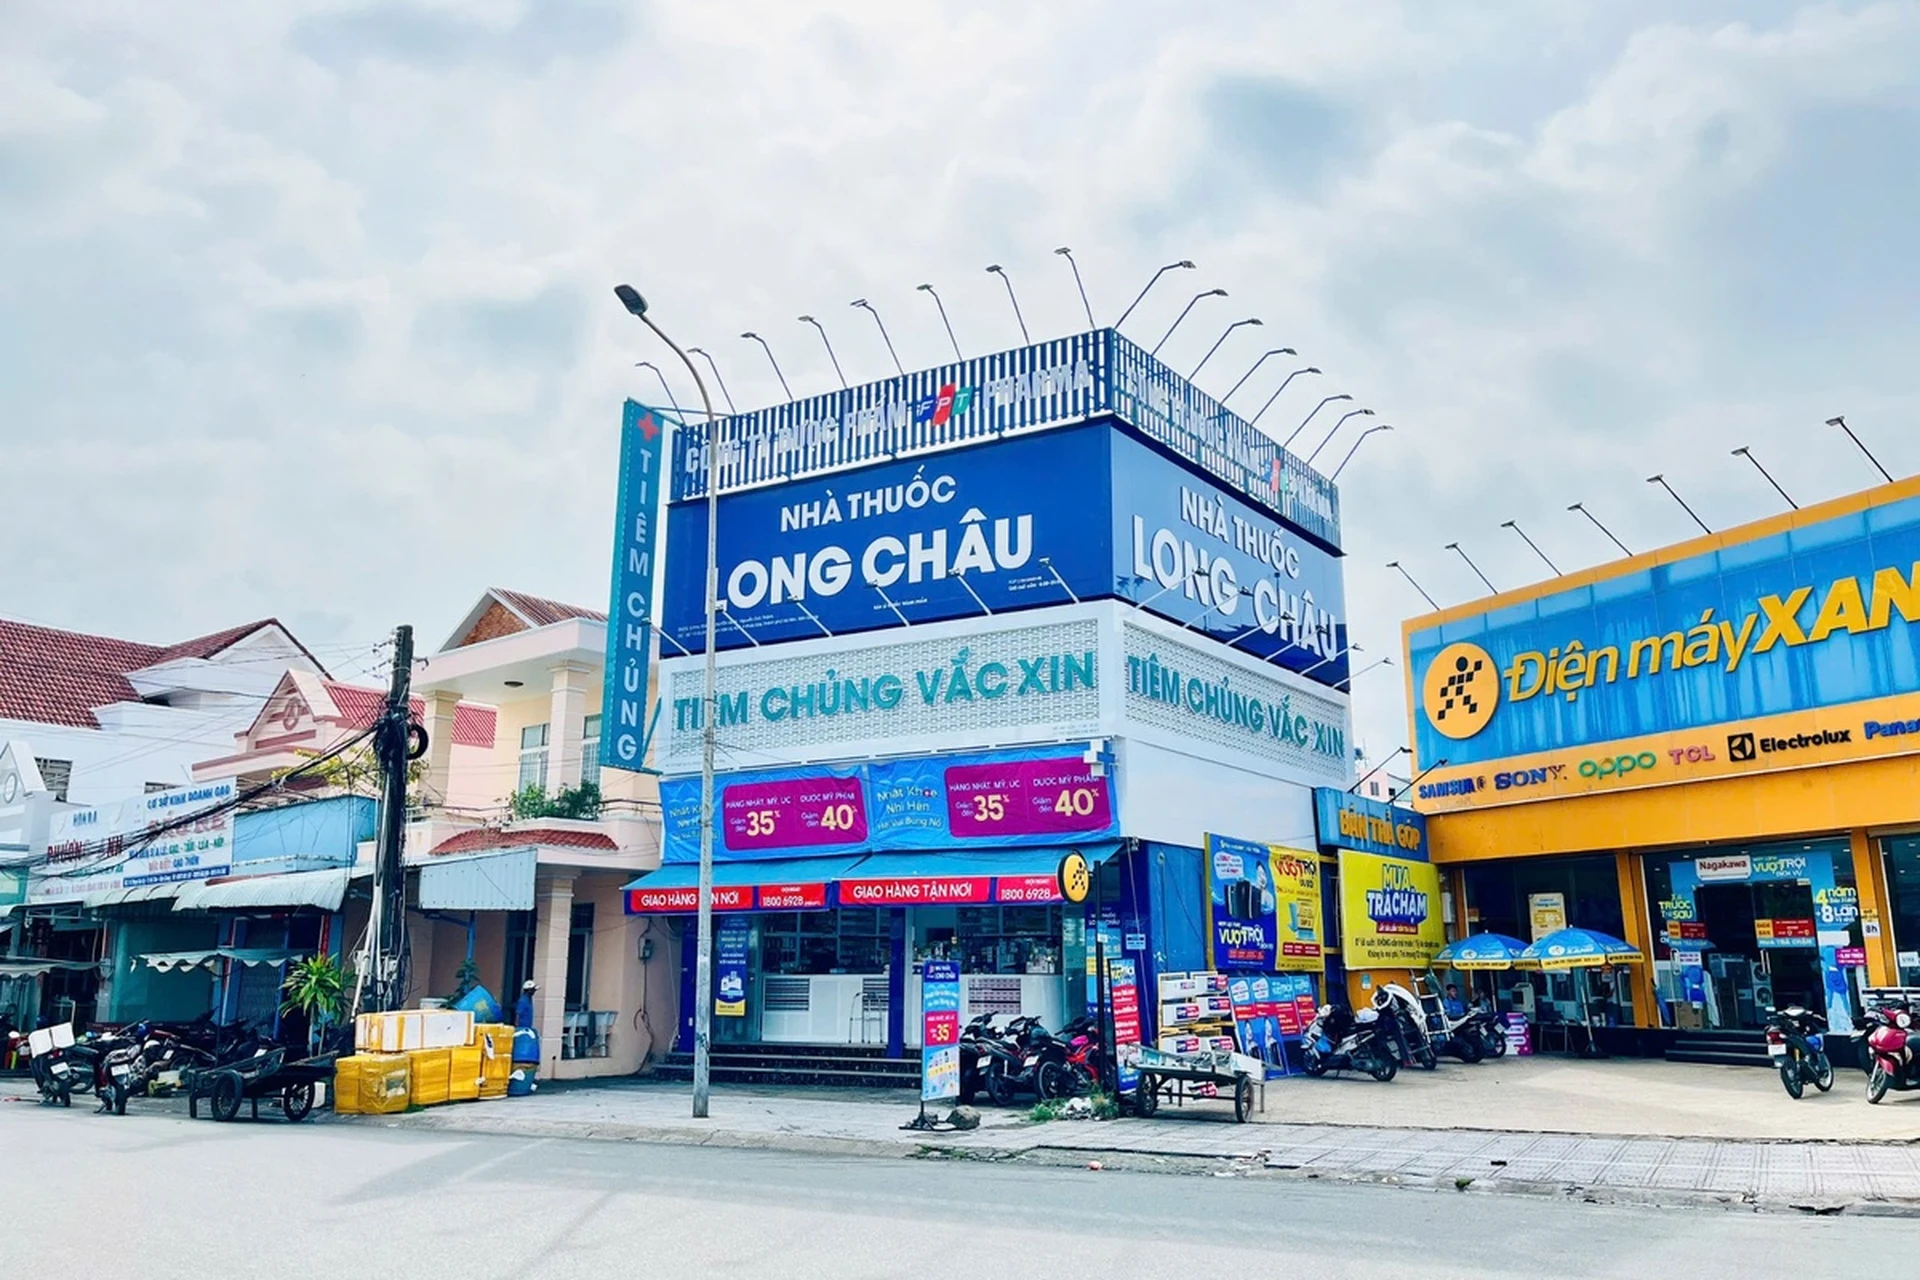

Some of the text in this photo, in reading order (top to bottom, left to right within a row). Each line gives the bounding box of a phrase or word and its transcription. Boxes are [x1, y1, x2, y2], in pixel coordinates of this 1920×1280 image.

[915, 383, 972, 423] FPT
[983, 358, 1090, 410] PHARMA
[780, 465, 957, 532] NHÀ THUỐC
[1180, 485, 1299, 580] NHÀ THUỐC
[705, 507, 1034, 614] LONG CHÂU
[617, 448, 653, 762] TIÊM CHỦNG
[1131, 513, 1338, 664] LONG CHÂU
[1506, 638, 1618, 703] Điện
[1627, 609, 1760, 672] máy
[760, 668, 904, 722] CHỦNG
[915, 645, 1010, 706] VẮC
[1016, 650, 1096, 695] XIN
[1128, 653, 1346, 757] TIÊM CHỦNG VẮC XIN
[1669, 745, 1716, 766] TCL
[1760, 729, 1852, 753] Electrolux
[1369, 810, 1395, 846] TRẢ
[1397, 818, 1421, 850] GÓP
[1383, 864, 1411, 891] MUA
[1700, 859, 1748, 872] Nagakawa
[641, 894, 667, 906] GIAO
[668, 890, 697, 906] HÀNG
[720, 892, 739, 904] NƠI
[763, 896, 782, 907] 1800
[783, 895, 804, 907] 6928
[853, 880, 972, 901] GIAO HÀNG TẬN NƠI
[1001, 888, 1051, 900] 1800 6928
[1816, 888, 1829, 906] 4
